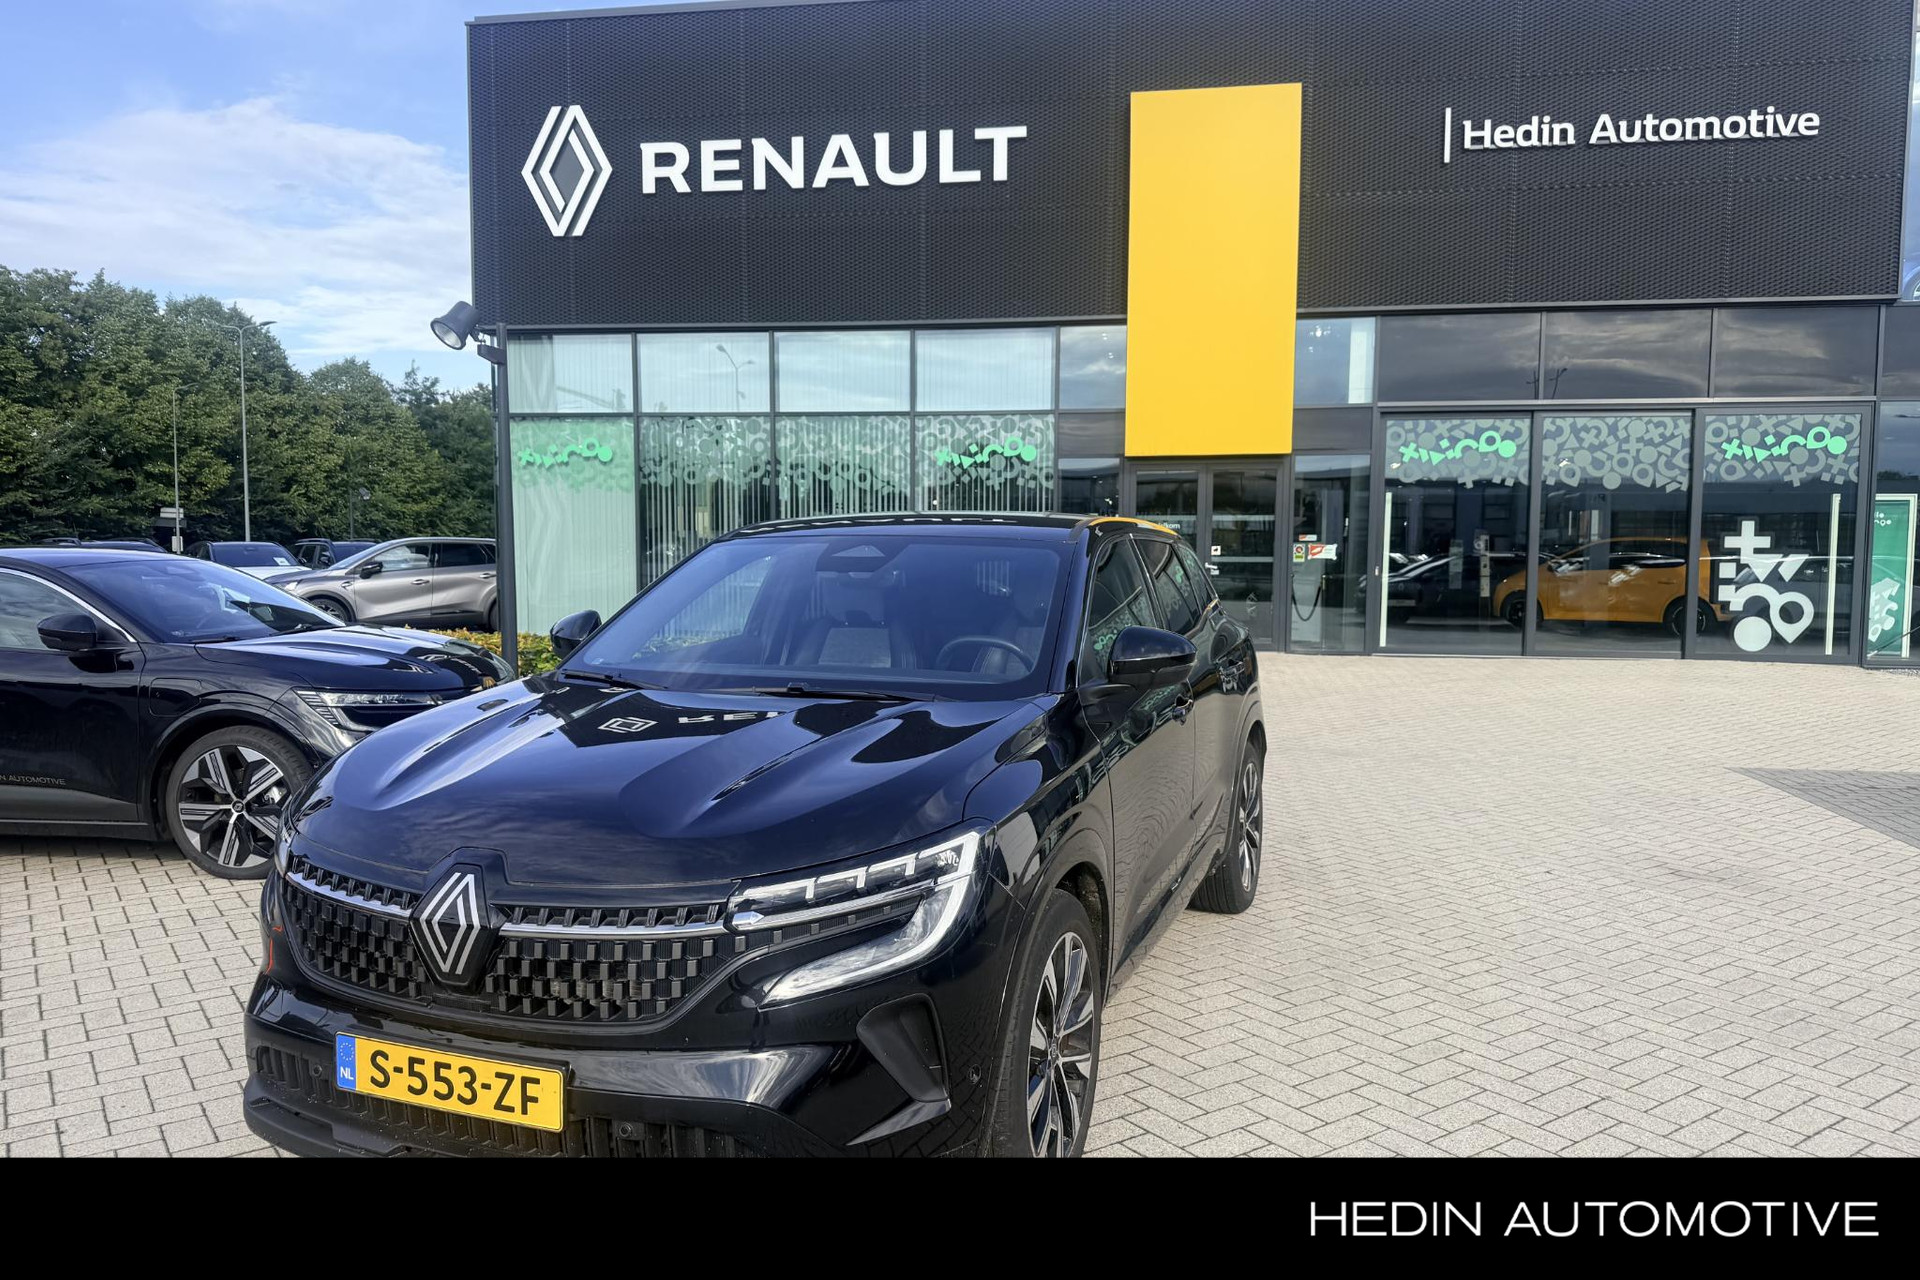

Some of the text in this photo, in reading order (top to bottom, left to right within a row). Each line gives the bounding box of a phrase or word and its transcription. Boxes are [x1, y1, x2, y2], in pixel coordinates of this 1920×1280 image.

[1462, 106, 1820, 150] Hedin Automotive
[639, 125, 1028, 194] RENAULT
[9, 775, 67, 785] AUTOMOTIVE
[340, 1066, 354, 1080] NL
[370, 1049, 541, 1116] S-553-ZF
